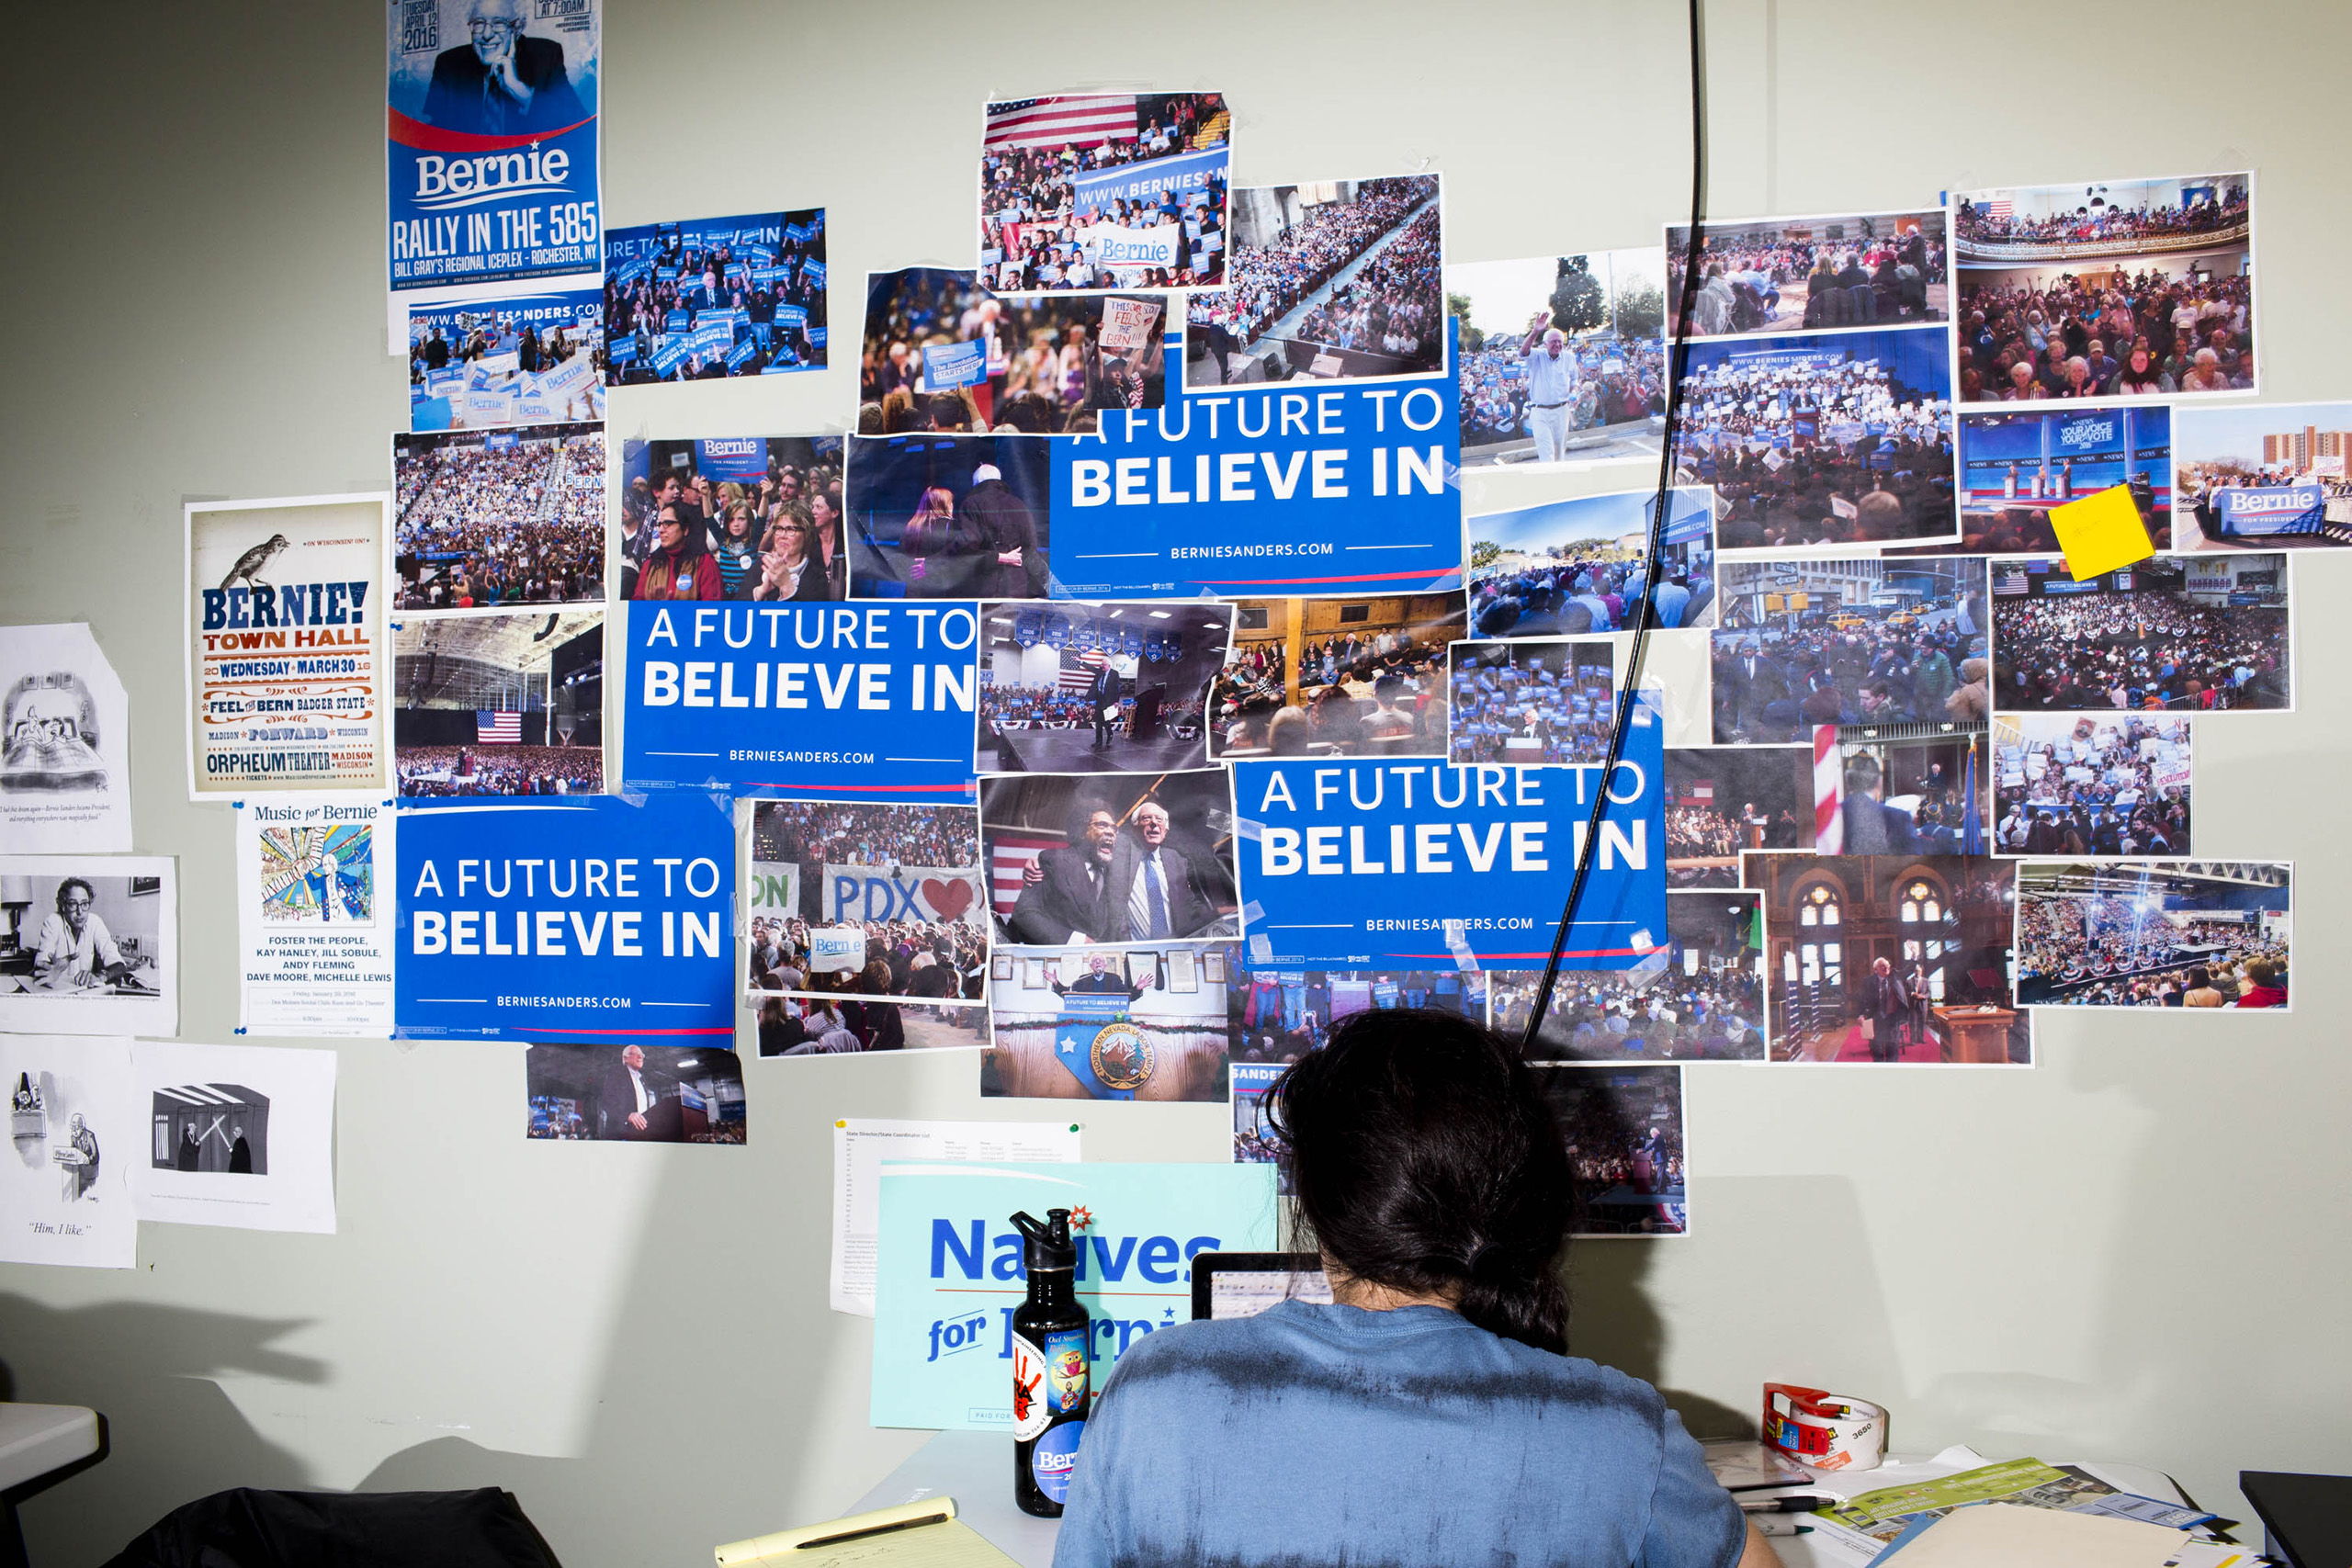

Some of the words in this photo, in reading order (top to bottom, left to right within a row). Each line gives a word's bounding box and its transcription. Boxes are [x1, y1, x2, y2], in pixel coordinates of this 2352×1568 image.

[404, 0, 435, 15] TUESDAY
[541, 3, 551, 16] AT
[554, 0, 584, 15] 7:00AM
[405, 14, 427, 28] APRIL
[428, 13, 437, 26] 12
[404, 27, 437, 51] 2016
[415, 139, 570, 197] Bernie
[393, 215, 459, 259] RALLY
[468, 212, 492, 254] IN
[497, 208, 542, 250] THE
[549, 201, 596, 246] 585
[760, 227, 780, 243] IN
[1102, 238, 1169, 262] Bernie
[394, 262, 412, 277] BILL
[413, 257, 443, 276] GRAY'S
[445, 254, 485, 274] REGIONAL
[488, 252, 522, 269] ICEPLEX
[531, 246, 583, 265] ROCHESTER,
[585, 244, 597, 260] NY
[1114, 310, 1142, 327] FEELS
[1117, 325, 1132, 334] THE
[935, 367, 965, 378] STARTS
[964, 362, 985, 373] HERE
[946, 355, 979, 369] Revolution
[546, 362, 584, 389] Bernie
[469, 397, 505, 410] Bernie
[1125, 392, 1347, 443] FUTURE
[1363, 389, 1444, 433] TO
[2086, 422, 2113, 432] VOICE
[2089, 431, 2113, 441] VOTE
[704, 437, 757, 454] Bernie
[1071, 449, 1349, 507] BELIEVE
[1373, 446, 1444, 498] IN
[2229, 490, 2314, 511] Bernie
[1170, 543, 1334, 558] BERNIESANDERS.COM
[202, 581, 369, 630] BERNIE!
[646, 608, 678, 647] A
[695, 608, 889, 649] FUTURE
[906, 608, 977, 650] TO
[202, 631, 286, 650] TOWN
[294, 628, 369, 647] HALL
[204, 667, 219, 676] 20
[220, 661, 290, 678] WEDNESDAY
[297, 660, 342, 674] MARCH
[342, 659, 355, 672] 30
[357, 662, 370, 671] 16
[643, 661, 891, 711] BELIEVE
[911, 664, 975, 713] IN
[209, 701, 244, 714] FEEL
[257, 700, 294, 713] BERN
[298, 698, 334, 711] BADGER
[336, 696, 366, 709] STATE
[208, 731, 239, 740] MADISON
[248, 728, 329, 741] FORWARD
[207, 753, 286, 773] ORPHEUM
[287, 751, 331, 772] THEATER
[331, 751, 373, 761] MADISON
[336, 761, 368, 770] WISCONSIN
[729, 750, 875, 764] BERNIESANDERS.COM
[1260, 770, 1297, 813] A
[1314, 766, 1544, 811] FUTURE
[1562, 760, 1645, 805] TO
[254, 806, 301, 821] Music
[305, 807, 320, 821] for
[323, 804, 378, 820] Bernie
[1261, 821, 1549, 876] BELIEVE
[1573, 819, 1647, 871] IN
[413, 860, 444, 897] A
[458, 859, 639, 898] FUTURE
[652, 858, 720, 898] TO
[834, 875, 927, 924] PDX
[1365, 917, 1533, 931] BERNIESANDERS.COM
[268, 937, 305, 945] FOSTER
[309, 937, 325, 945] THE
[329, 937, 368, 946] PEOPLE,
[413, 911, 643, 957] BELIEVE
[662, 911, 720, 958] IN
[256, 949, 276, 957] KAY
[279, 949, 320, 958] HANLEY,
[322, 949, 338, 957] JILL
[342, 949, 382, 958] SOBULE,
[283, 961, 309, 970] ANDY
[312, 961, 355, 970] FLEMING
[274, 974, 311, 983] MOORE,
[314, 974, 360, 982] MICHELLE
[364, 974, 392, 983] LEWIS
[496, 996, 631, 1009] BERNIESANDERS.COM
[1091, 1033, 1105, 1075] NORTHERN
[1102, 1025, 1131, 1036] NEVADA
[1132, 1029, 1150, 1049] LABOR
[1142, 1051, 1153, 1077] TEMPLE
[930, 1218, 1222, 1284] Naives
[928, 1308, 987, 1362] for
[976, 1412, 991, 1420] PAID
[994, 1412, 1011, 1420] FOR
[1852, 1424, 1872, 1440] 3650
